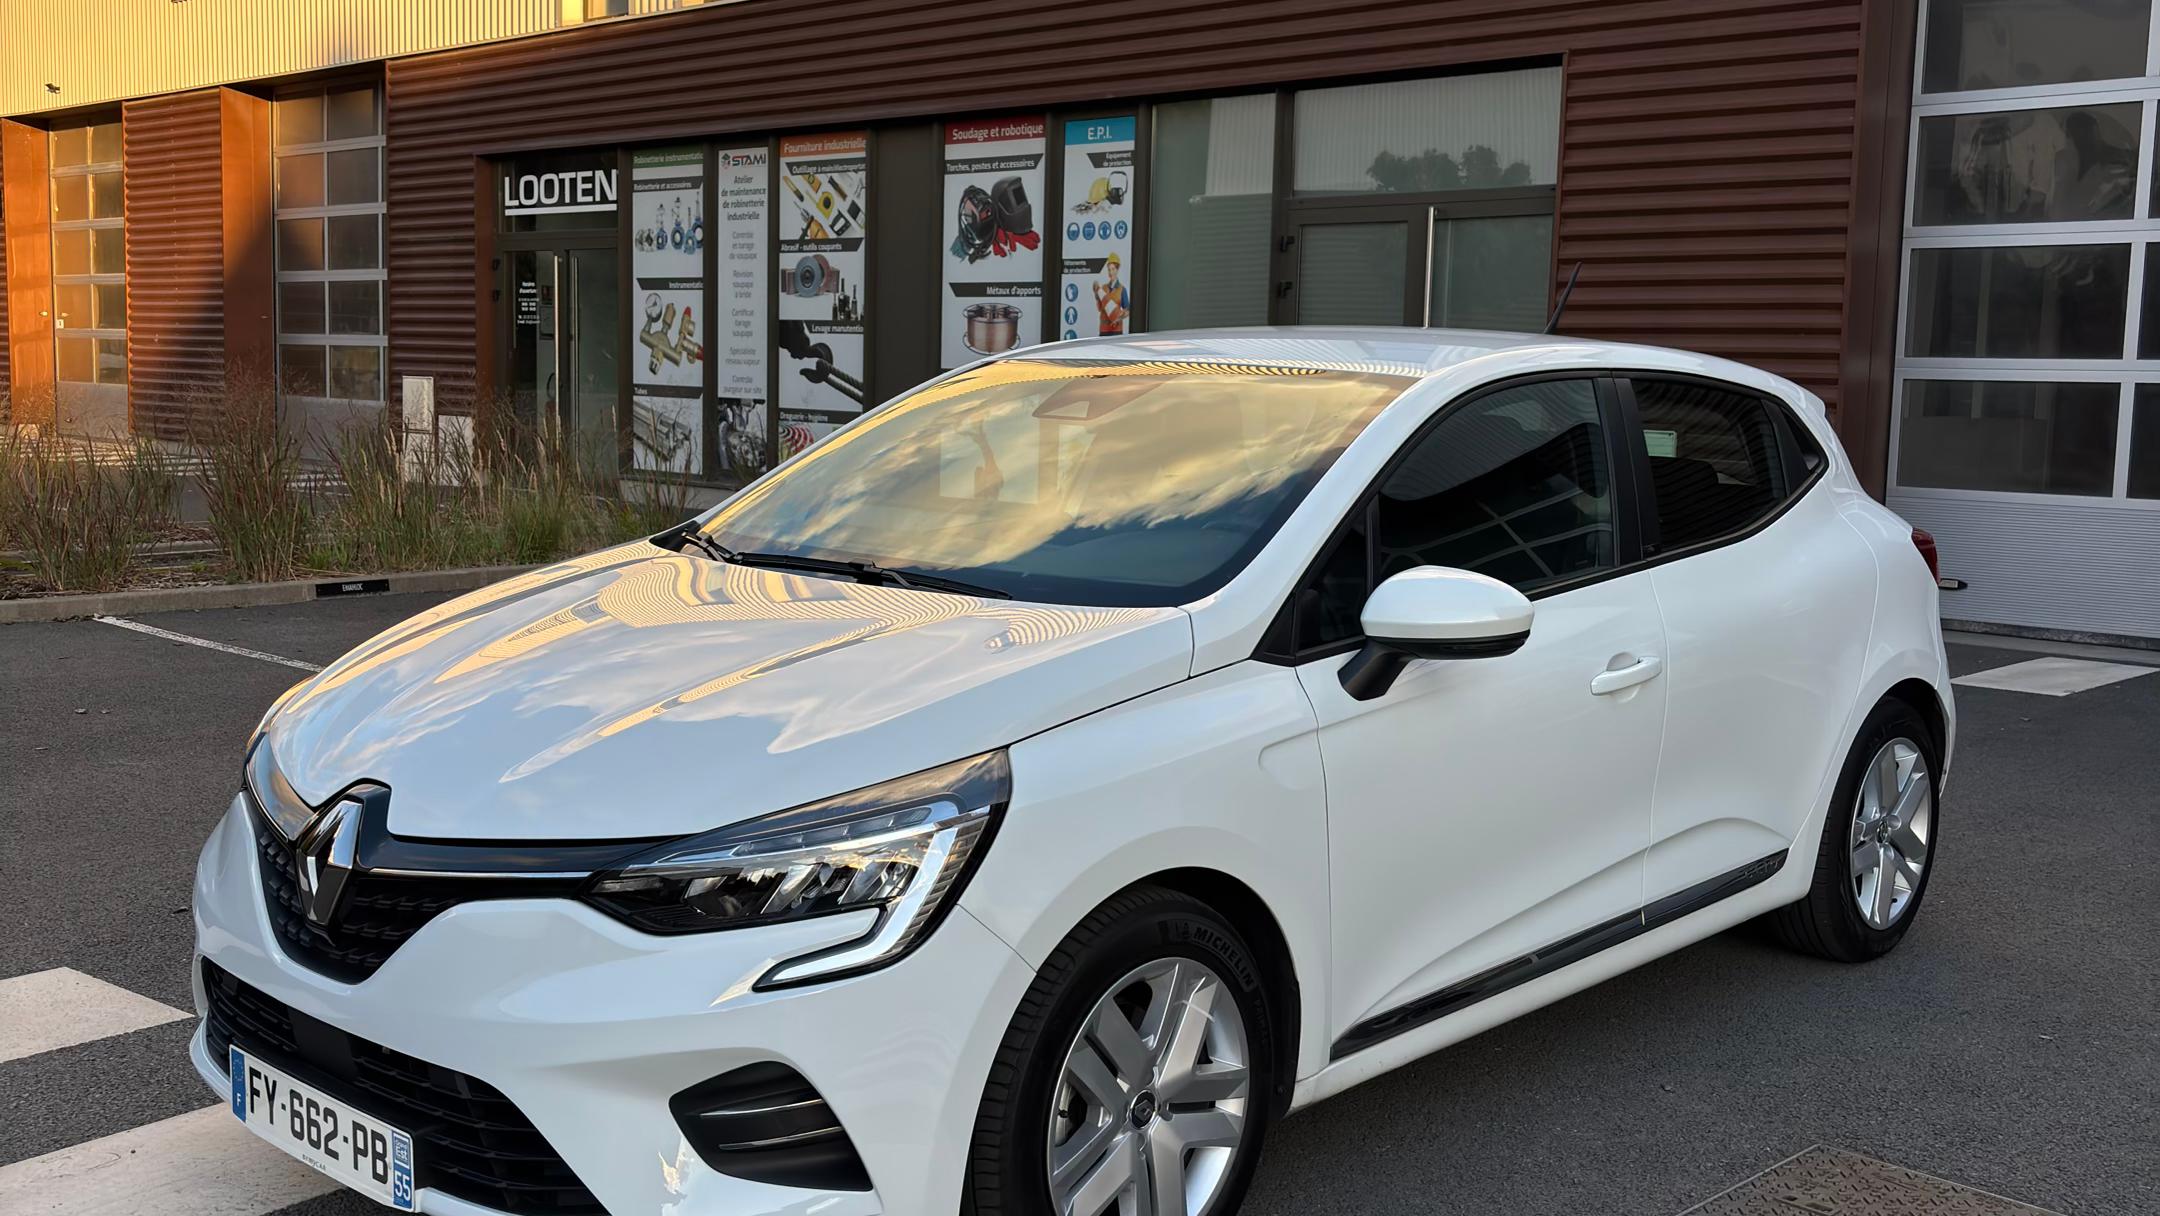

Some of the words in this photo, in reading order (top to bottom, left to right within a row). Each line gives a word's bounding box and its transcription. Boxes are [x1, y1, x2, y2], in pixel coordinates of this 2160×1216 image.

[952, 128, 988, 141] Soudage
[990, 126, 999, 137] et
[1001, 123, 1043, 137] robotique
[1087, 125, 1112, 140] E.P.I.
[784, 143, 823, 153] Fourniture
[824, 137, 866, 150] industrielle
[732, 153, 766, 166] STAMI
[947, 163, 970, 172] Torches,
[971, 162, 991, 172] postes
[992, 161, 999, 169] et
[1000, 159, 1035, 169] accessoires
[792, 165, 817, 174] Outillage
[666, 181, 692, 189] accessoires
[734, 175, 753, 184] Atelier
[505, 169, 617, 206] LOOTEN
[721, 188, 728, 196] de
[729, 187, 766, 196] maintenance
[722, 200, 729, 208] de
[731, 199, 765, 208] robinetterie
[727, 211, 760, 220] industrielle
[803, 243, 817, 251] outils
[1011, 285, 1041, 297] d'apports
[812, 323, 831, 334] Levage
[832, 325, 864, 333] manutentio
[634, 387, 648, 395] Tubes
[1193, 927, 1254, 988] MICHELIN
[236, 1092, 241, 1107] F
[249, 1066, 388, 1185] FY-662-PB
[394, 1172, 411, 1201] 55
